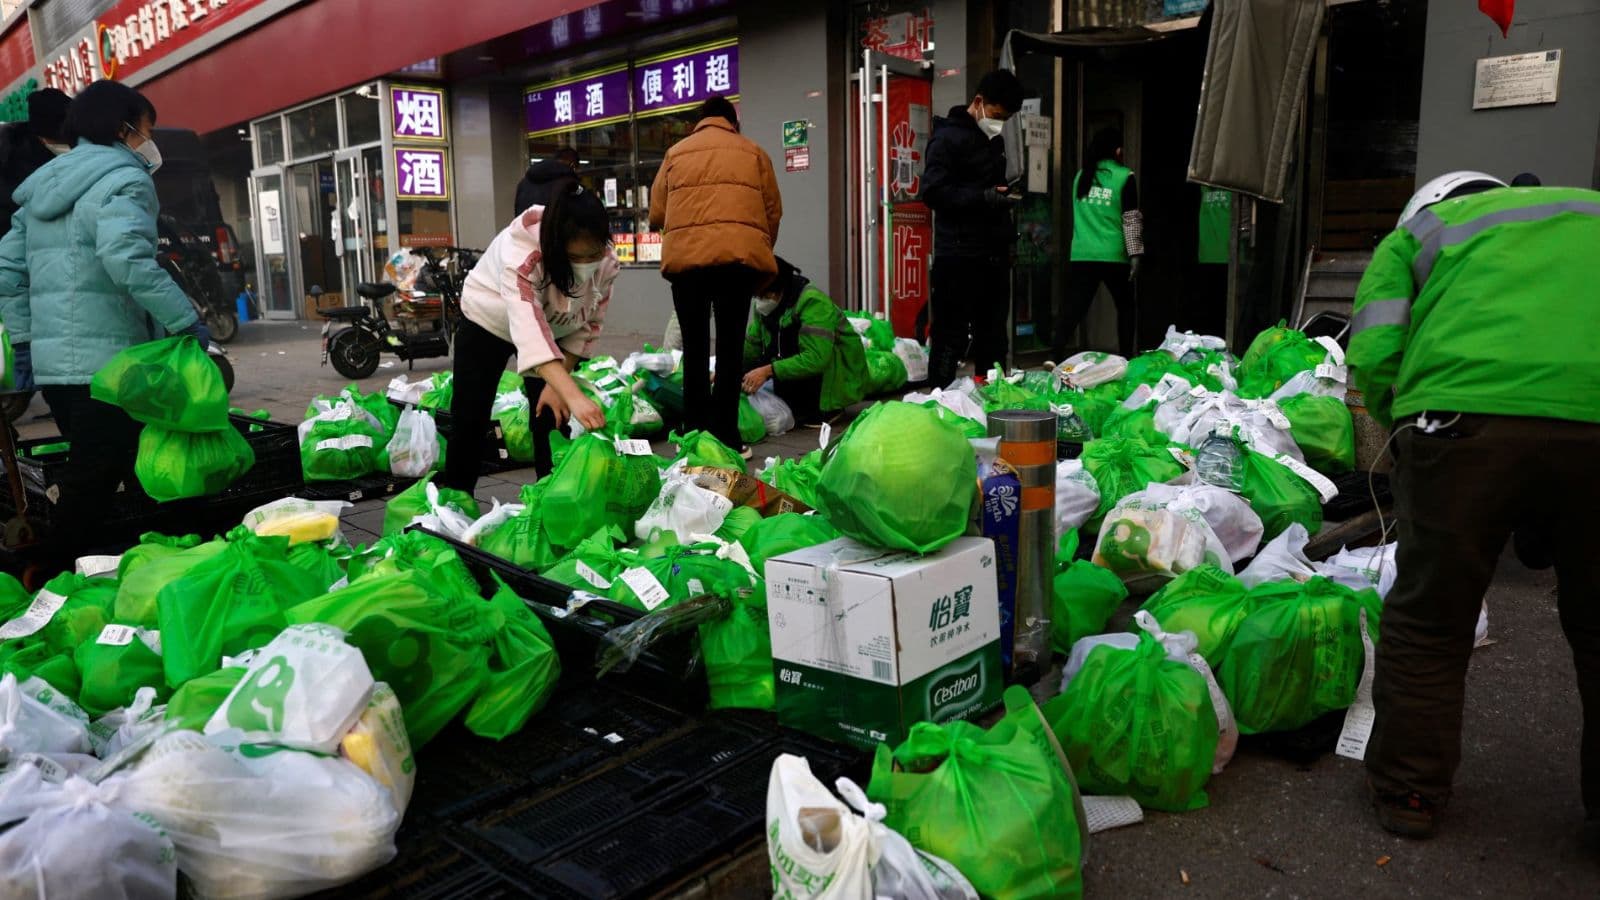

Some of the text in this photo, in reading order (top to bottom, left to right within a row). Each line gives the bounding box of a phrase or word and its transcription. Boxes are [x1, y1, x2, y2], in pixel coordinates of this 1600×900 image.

[553, 54, 731, 123] 烟酒 便利超
[397, 91, 441, 136] 烟
[400, 152, 442, 194] 酒
[989, 486, 1003, 522] Vinda
[929, 584, 974, 632] 怡寶
